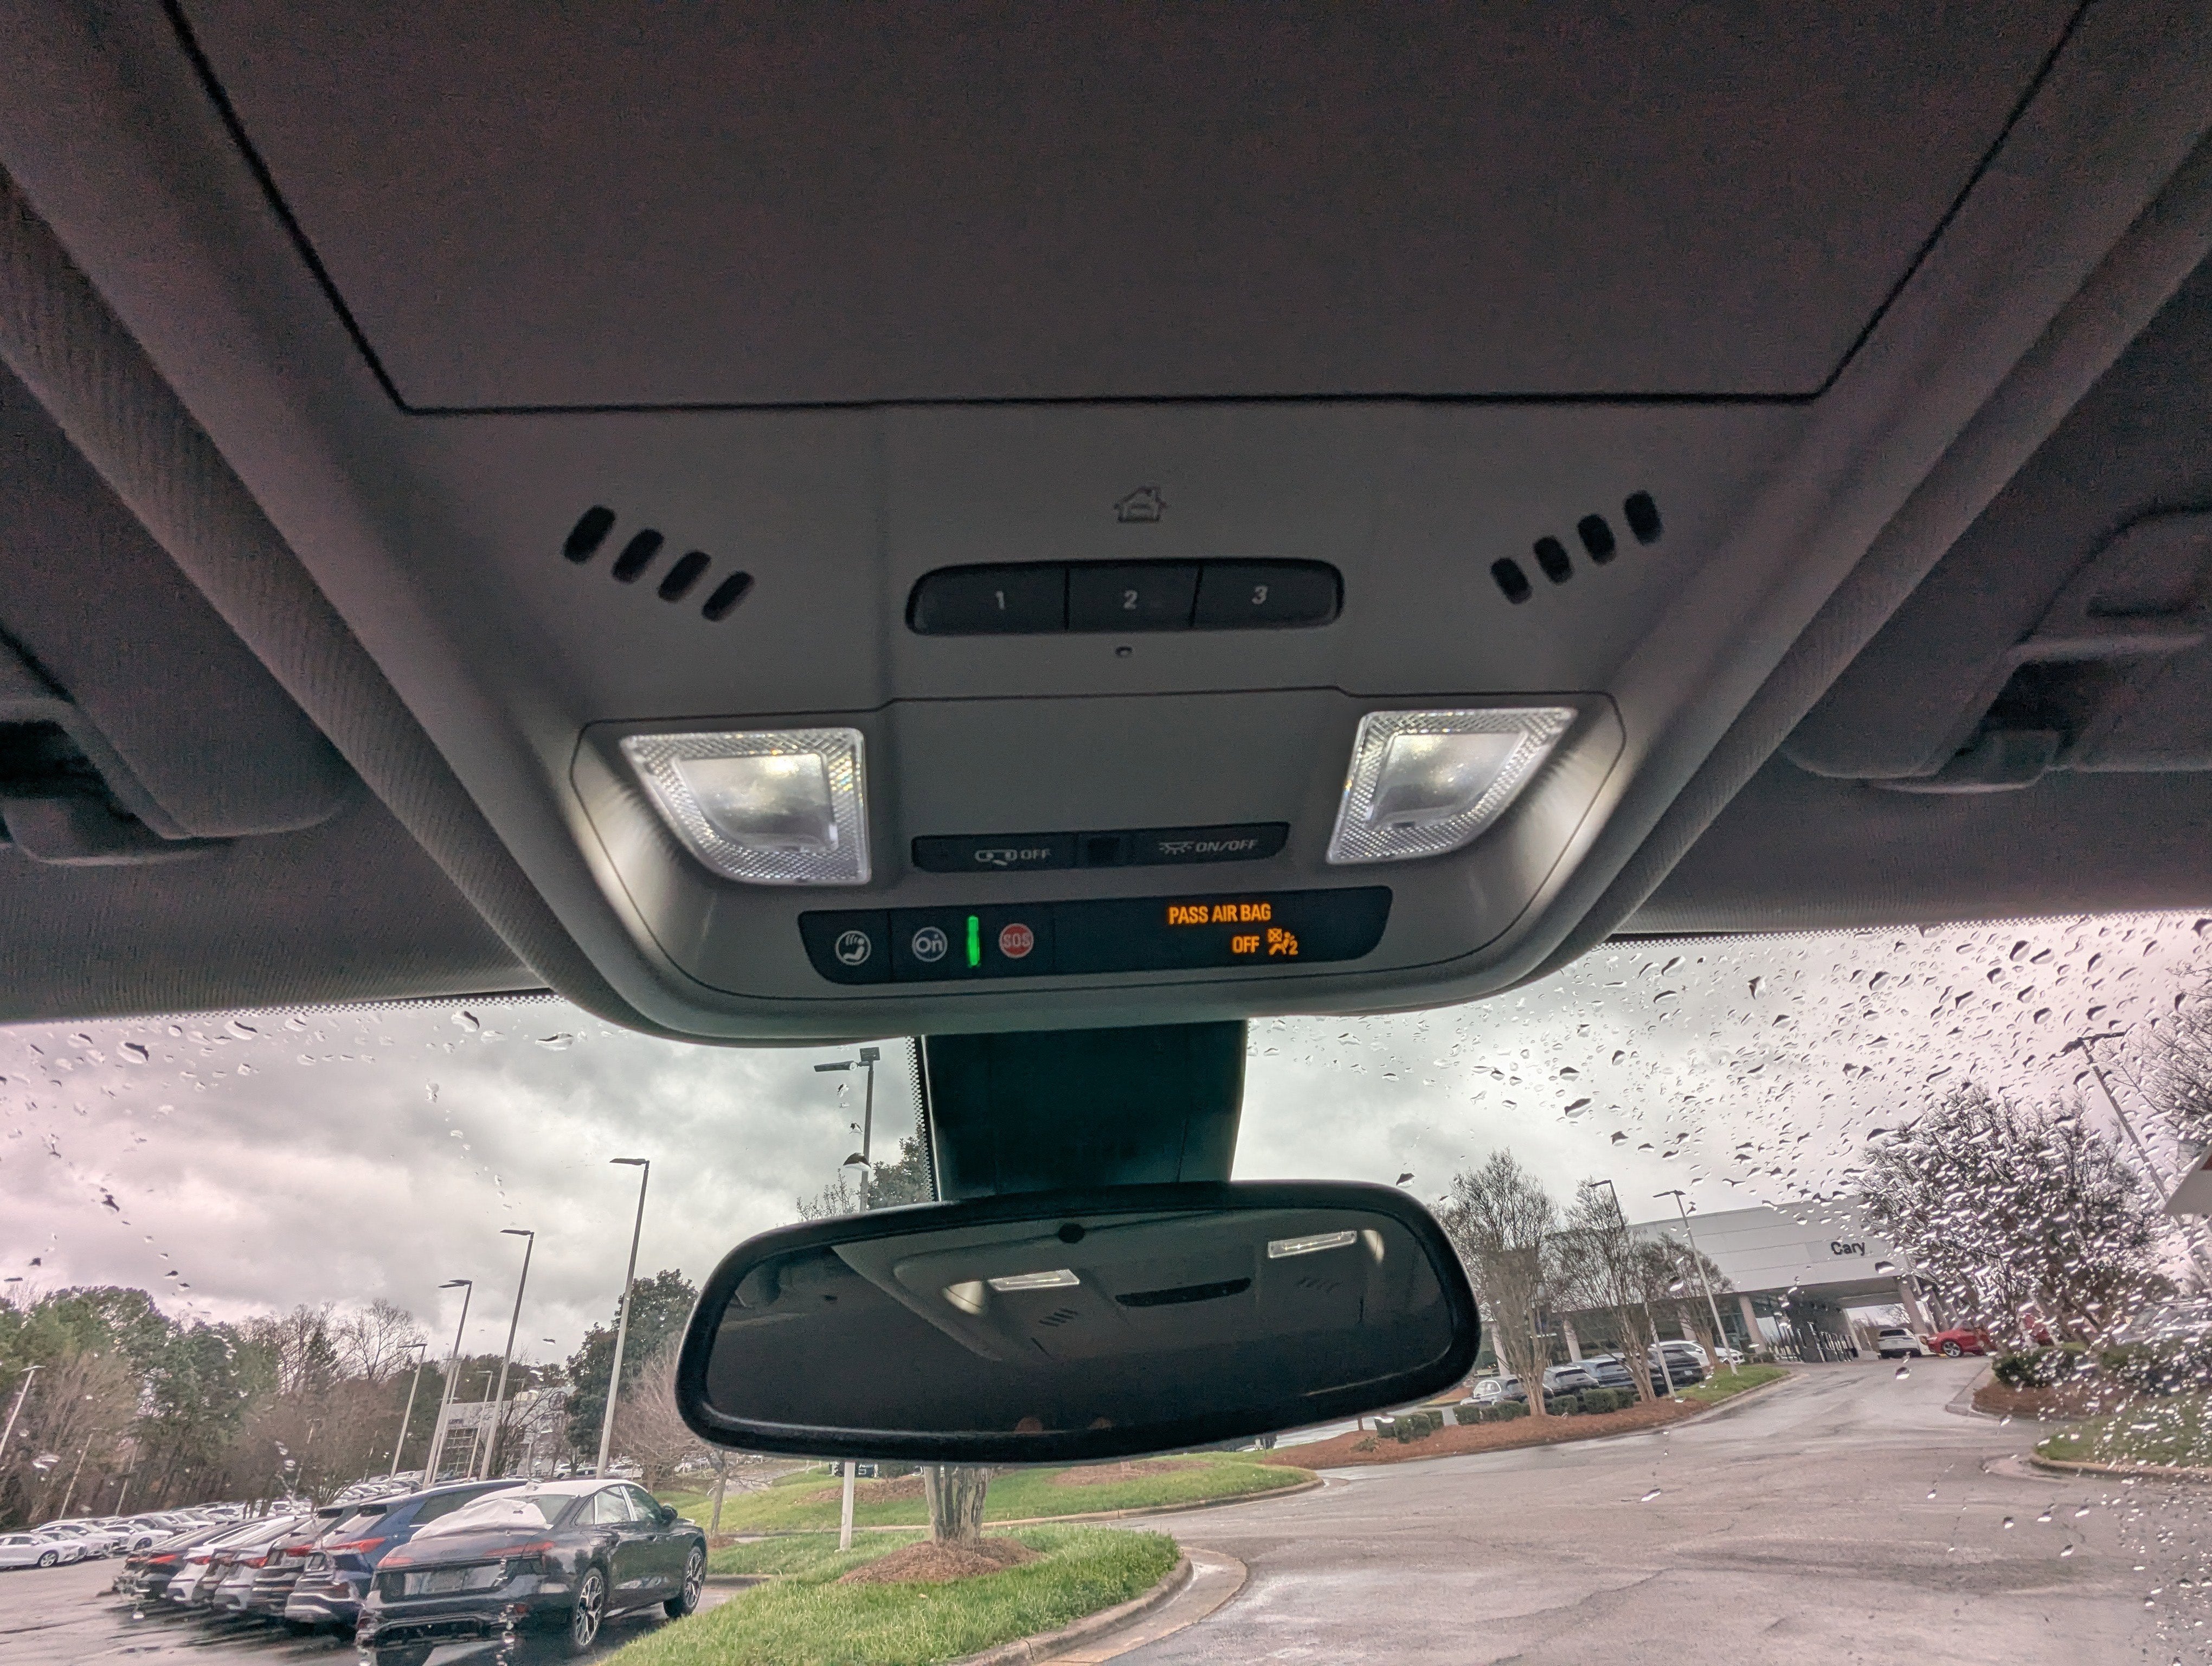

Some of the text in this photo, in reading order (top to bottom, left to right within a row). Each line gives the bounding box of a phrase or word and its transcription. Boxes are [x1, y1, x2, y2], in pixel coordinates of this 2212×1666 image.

[996, 591, 1006, 610] 1
[1124, 590, 1138, 610] 2
[1252, 586, 1268, 605] 3
[1021, 849, 1051, 860] OFF
[1196, 840, 1258, 853] ON/OFF
[1169, 903, 1271, 924] PASS AIR BAG
[915, 934, 943, 952] On
[1003, 934, 1030, 947] SOS
[1232, 935, 1260, 953] OFF
[1831, 1241, 1865, 1256] Cary
